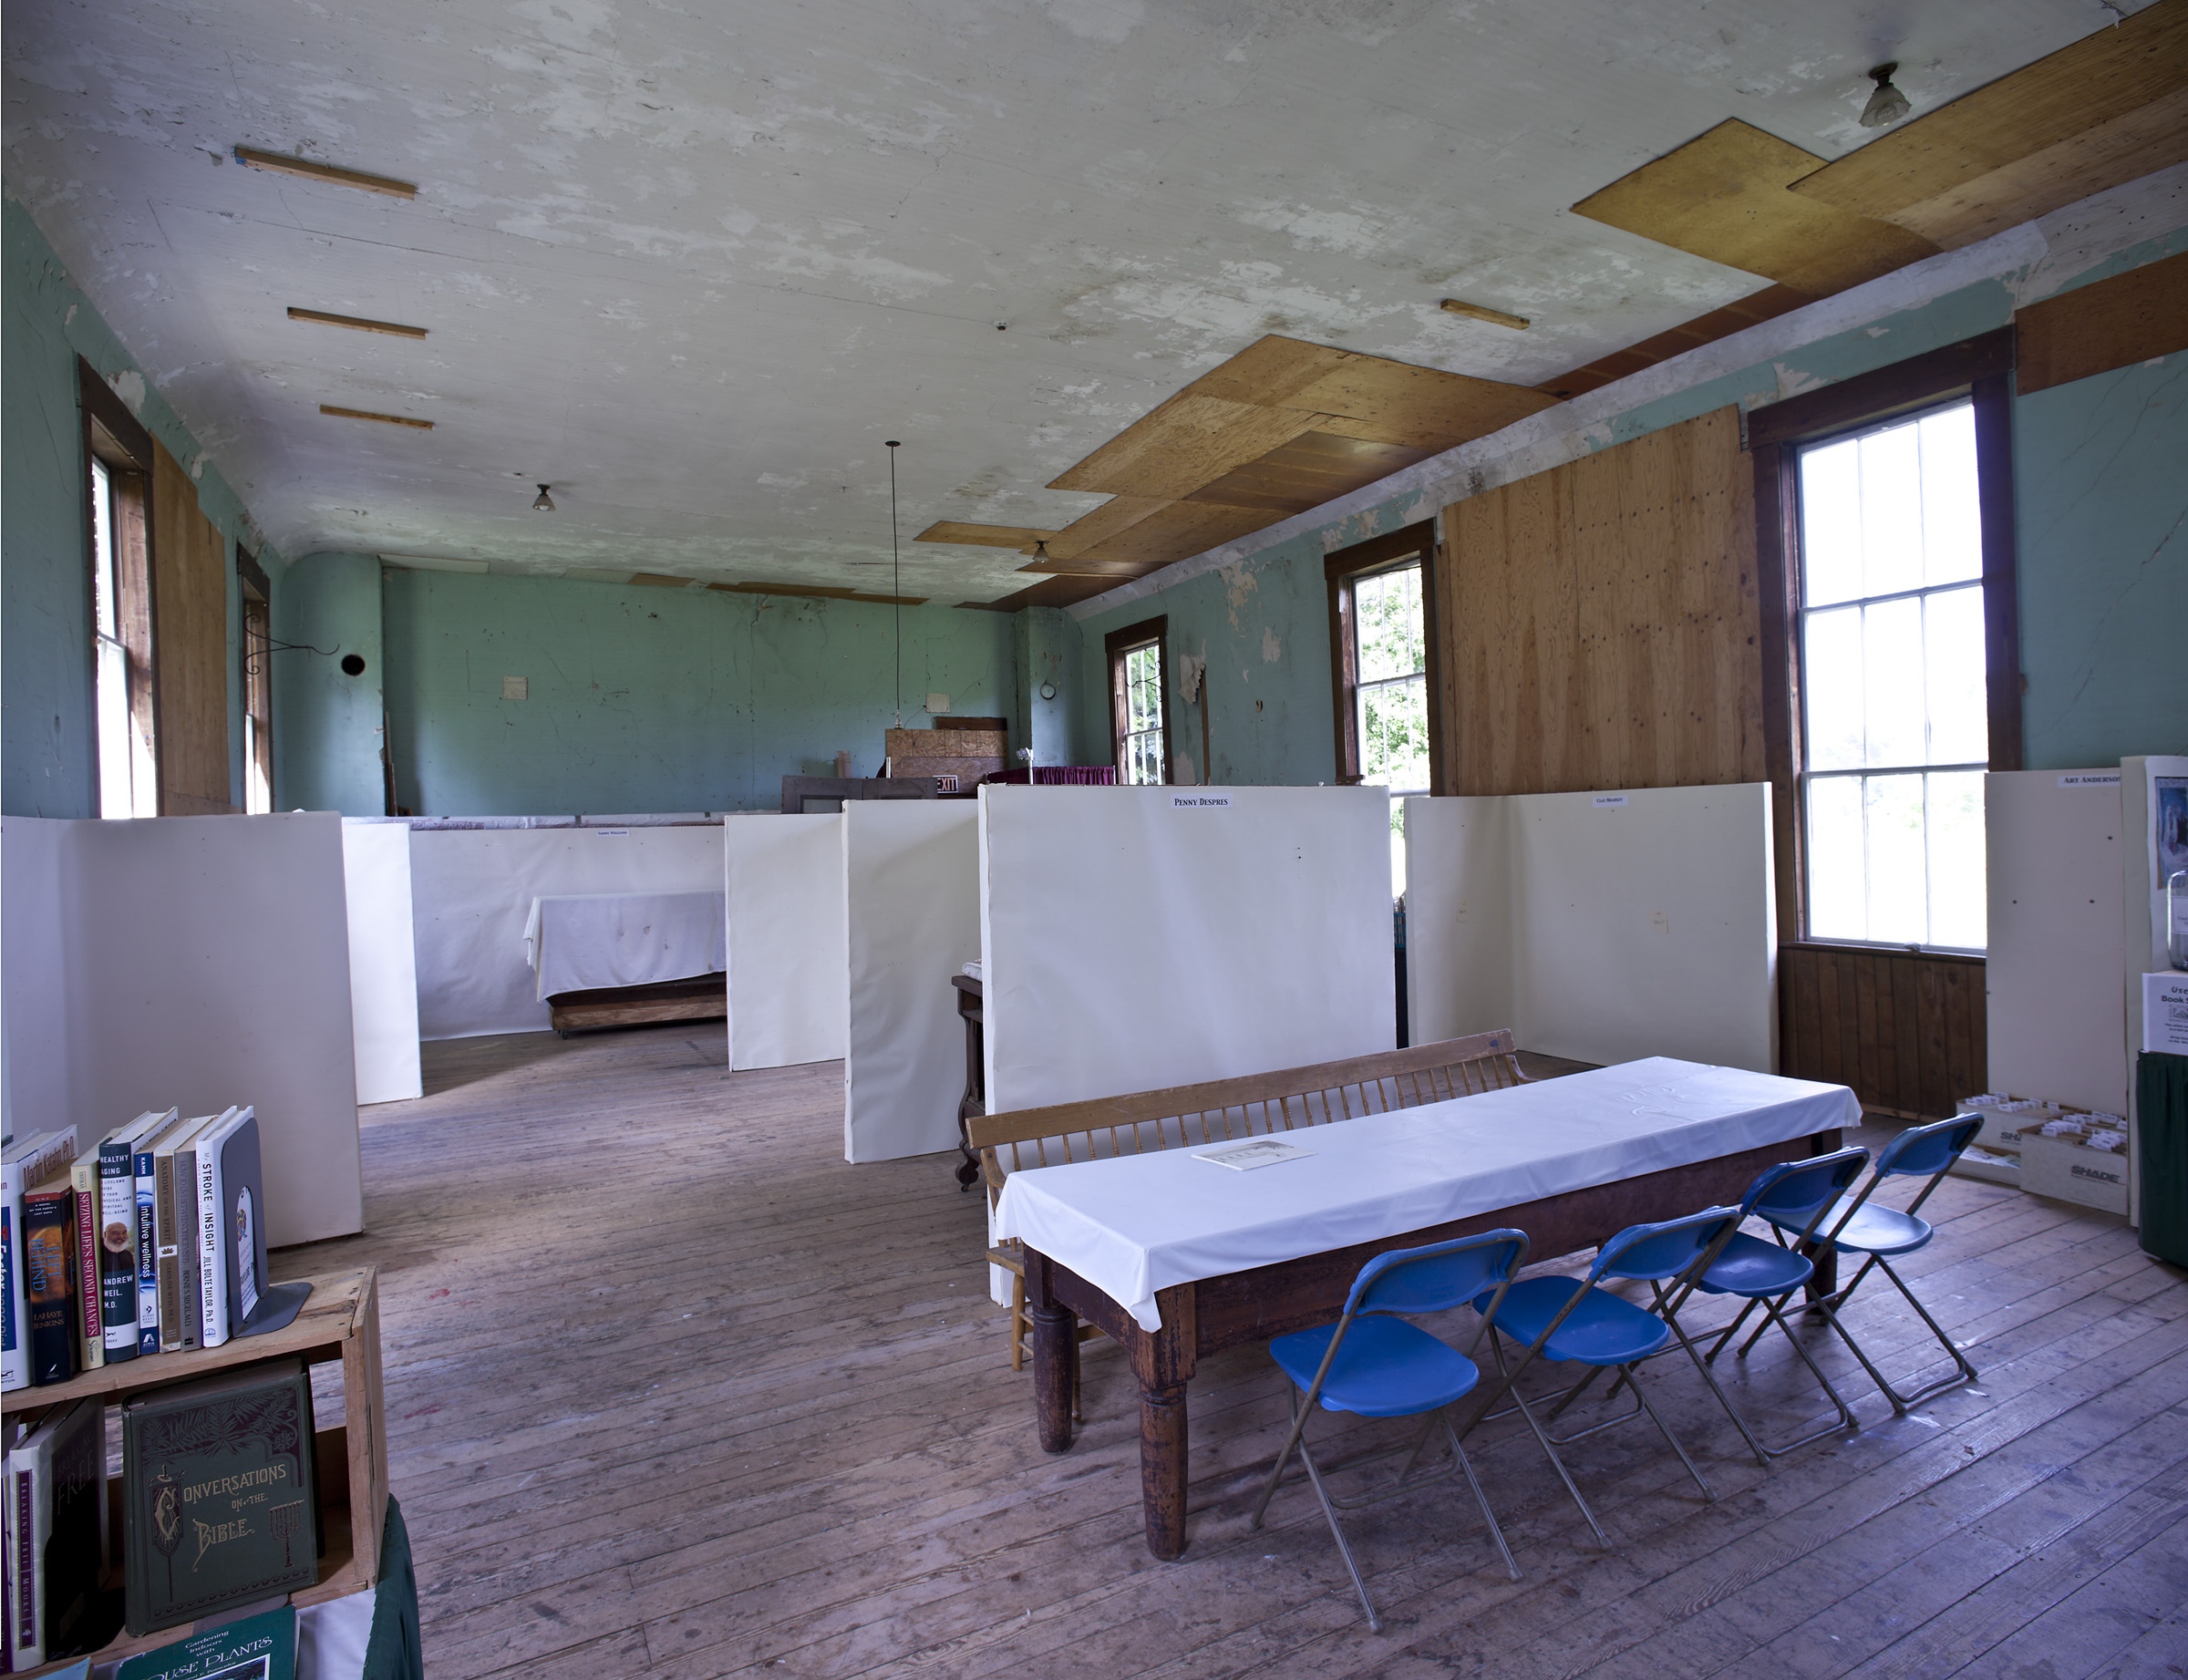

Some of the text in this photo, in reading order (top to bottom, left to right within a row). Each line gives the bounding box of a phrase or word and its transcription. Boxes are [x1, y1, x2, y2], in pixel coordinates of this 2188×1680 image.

[937, 778, 955, 790] EXIT
[1174, 798, 1228, 806] PENNY DESPRES
[2162, 995, 2184, 1004] Book
[2000, 1131, 2020, 1141] SHA
[100, 1154, 129, 1163] HEALTHY
[23, 1159, 44, 1190] Martin
[100, 1167, 120, 1175] AGING
[160, 1160, 169, 1195] ANATOMY
[2070, 1165, 2121, 1183] SHADE
[202, 1163, 213, 1201] STROKE
[78, 1193, 91, 1232] SEIZING
[162, 1218, 170, 1241] SPIRIT
[204, 1212, 215, 1252] INSIGHT
[81, 1232, 93, 1258] LIFE'S
[140, 1205, 152, 1278] intuitive wellness
[29, 1238, 46, 1292] BEHIND
[46, 1246, 61, 1278] LEFT
[203, 1256, 212, 1268] JILL
[83, 1259, 96, 1293] SECOND
[103, 1274, 134, 1285] ANDREW
[203, 1269, 212, 1285] BOLTE
[33, 1310, 63, 1321] LAHAYE
[85, 1295, 98, 1336] CHANCES
[104, 1301, 118, 1309] M.D.
[33, 1318, 65, 1330] JENKINS
[57, 1449, 95, 1516] FREE
[154, 1464, 286, 1541] CONVERSATIONS
[231, 1497, 243, 1512] ON
[192, 1518, 256, 1572] BIBLE
[22, 1578, 30, 1613] MOORE
[184, 1630, 230, 1649] Gardening
[190, 1639, 222, 1653] Indoors
[145, 1635, 274, 1680] OUSE PLANTS
[195, 1647, 215, 1657] with
